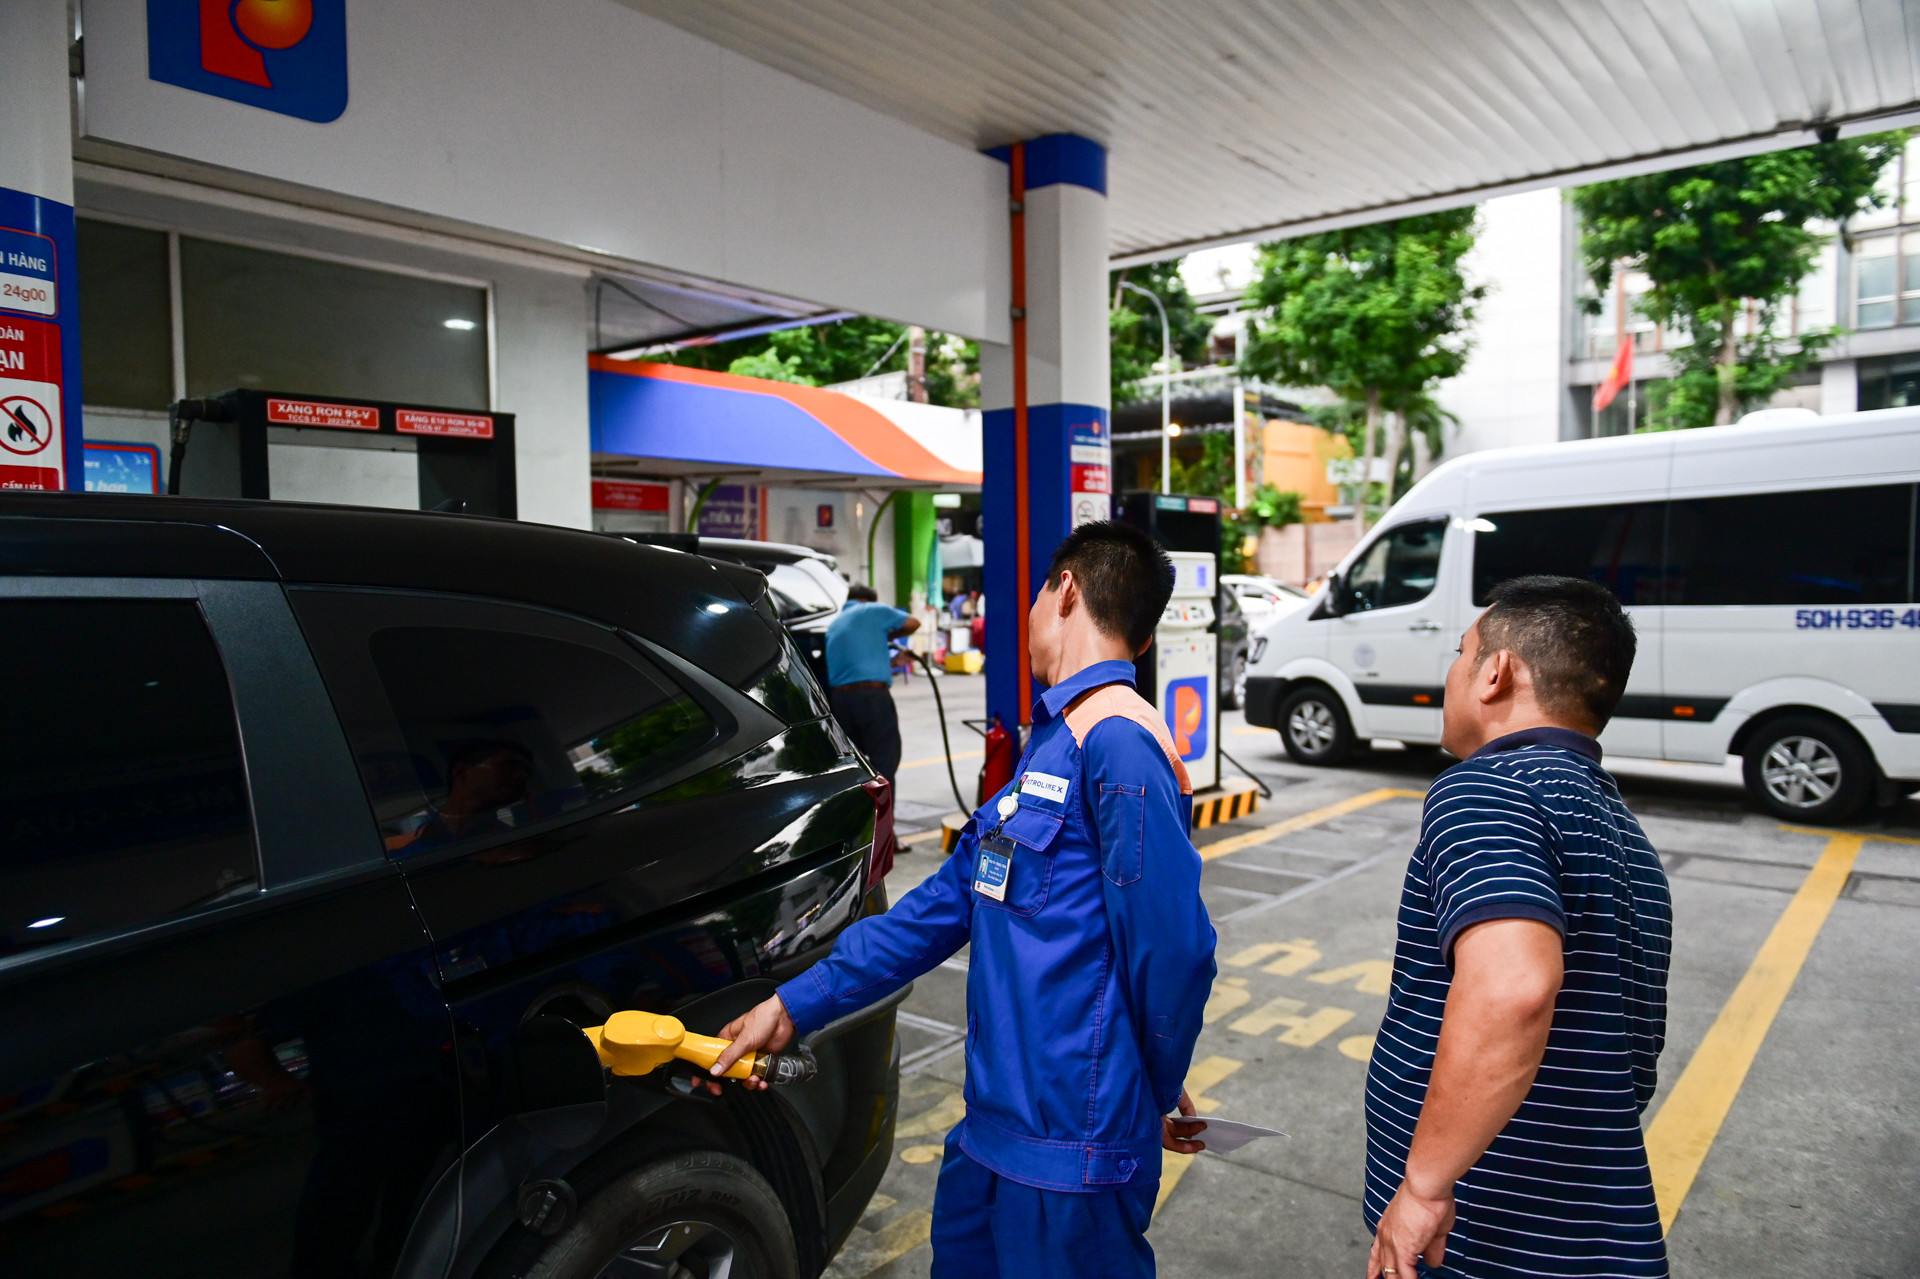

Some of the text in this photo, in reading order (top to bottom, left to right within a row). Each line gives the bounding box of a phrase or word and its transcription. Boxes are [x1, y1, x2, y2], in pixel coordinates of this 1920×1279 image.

[8, 251, 47, 272] HÀNG
[3, 283, 47, 302] 24g00
[0, 349, 25, 372] ẠN
[316, 407, 343, 417] RON
[345, 409, 370, 420] 95-V
